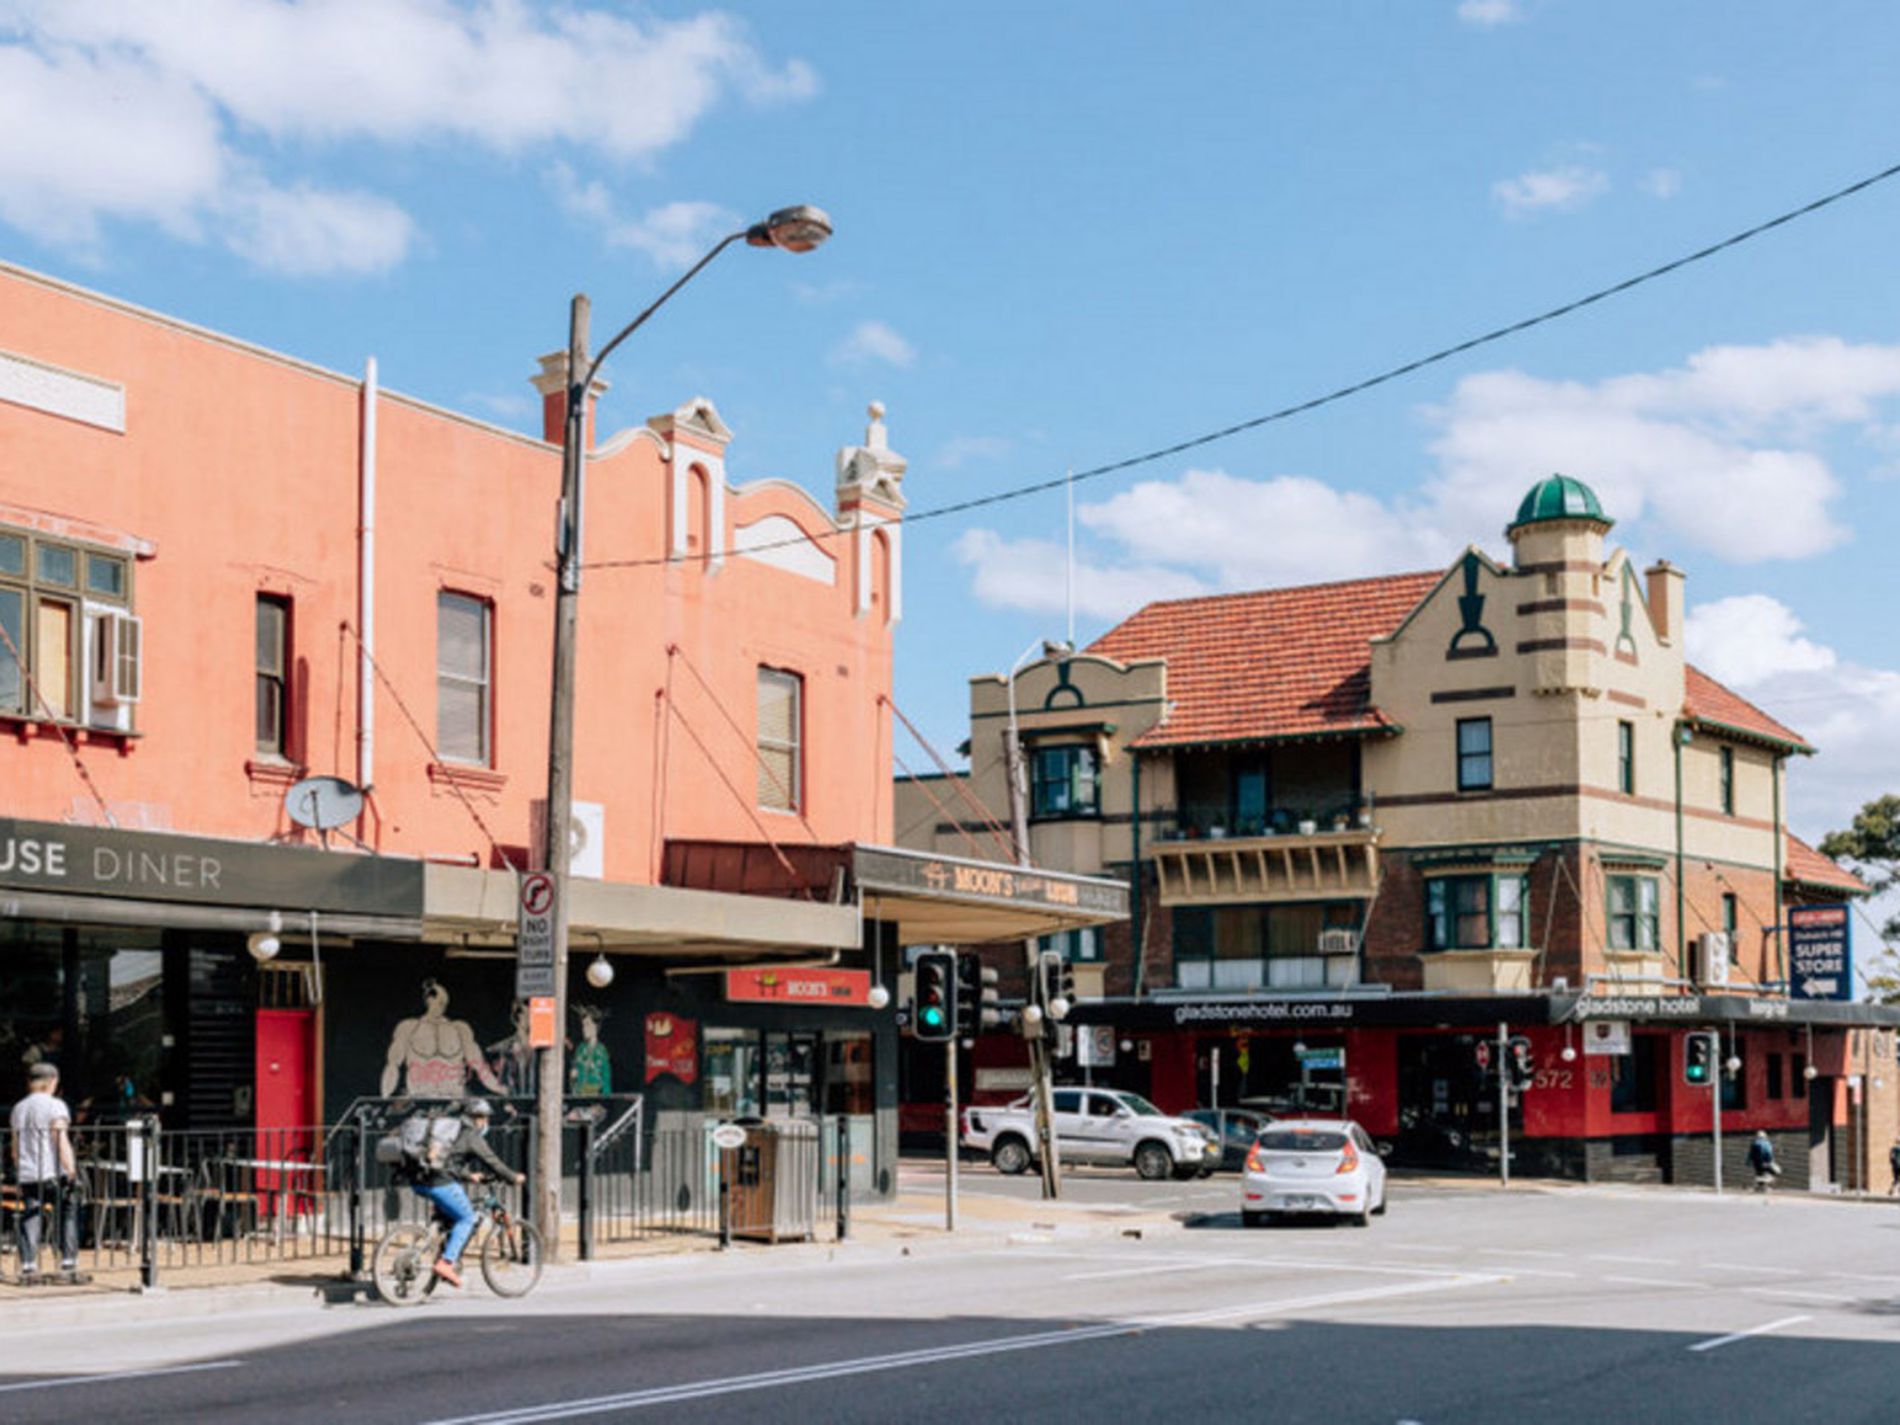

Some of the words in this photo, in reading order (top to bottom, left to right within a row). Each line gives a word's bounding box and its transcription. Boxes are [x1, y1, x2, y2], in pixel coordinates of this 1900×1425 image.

[93, 847, 223, 889] DINER
[526, 919, 548, 934] NO
[1796, 943, 1842, 958] SUPER
[1796, 959, 1842, 974] STORE
[1174, 1003, 1353, 1025] gladstonehotel.com.au
[1575, 996, 1656, 1022] gladstone
[1659, 998, 1700, 1016] hotel
[1535, 1069, 1574, 1089] 572
